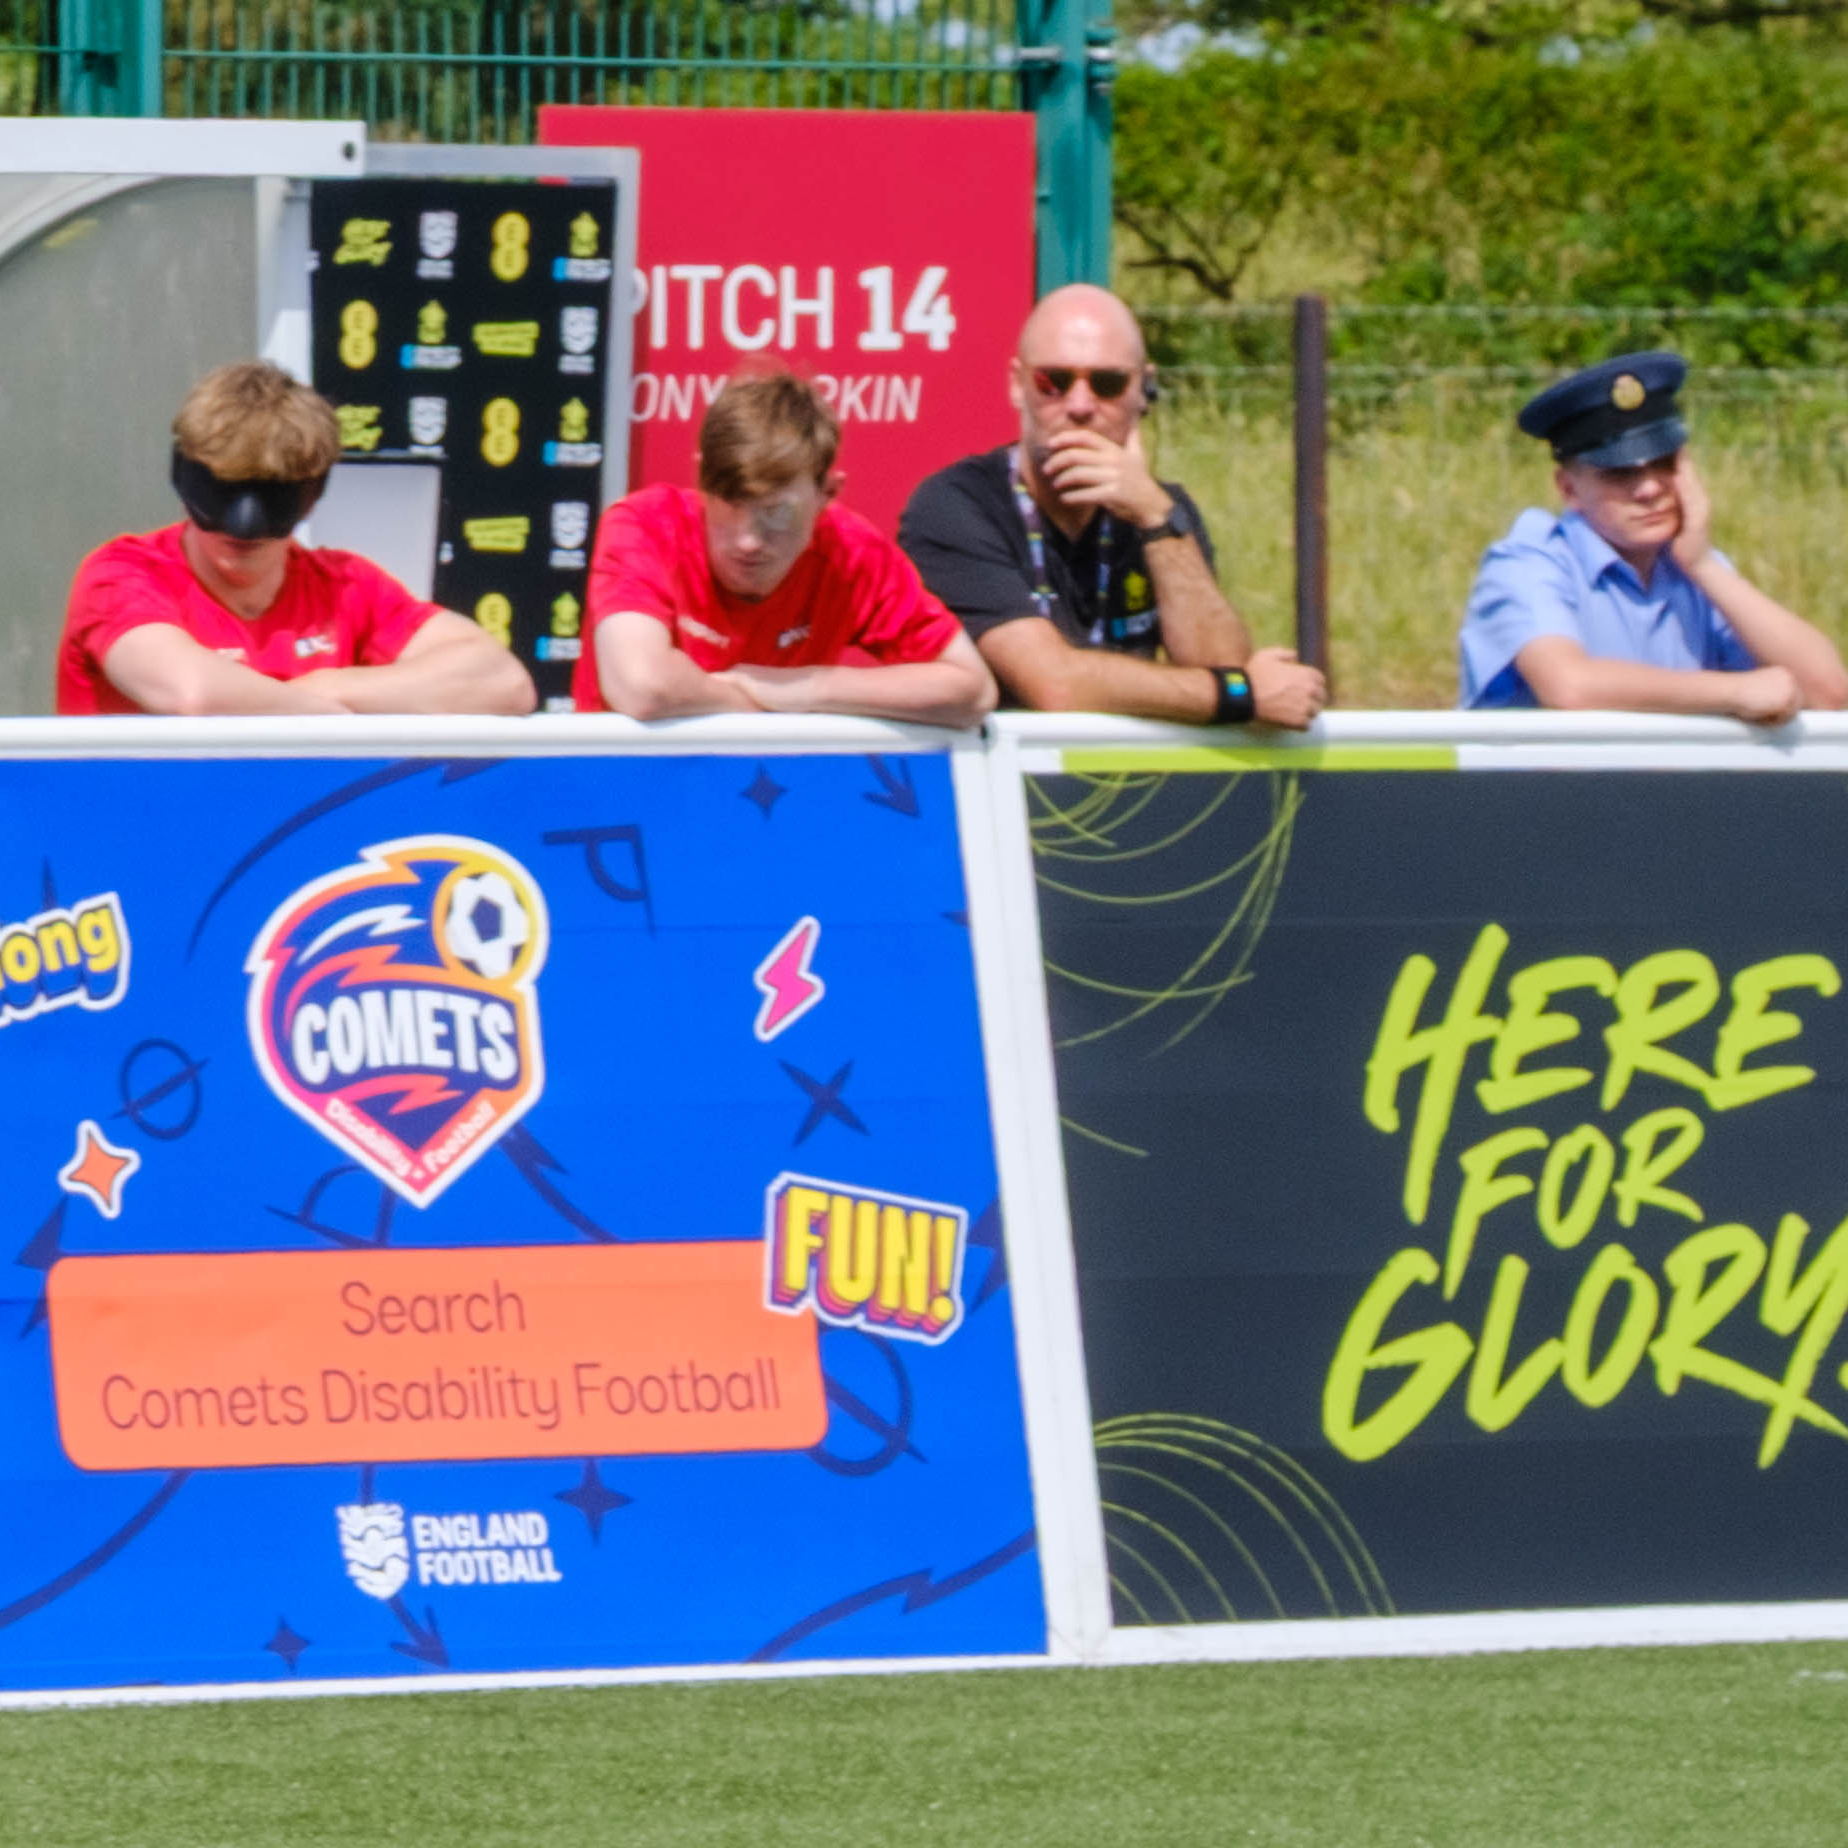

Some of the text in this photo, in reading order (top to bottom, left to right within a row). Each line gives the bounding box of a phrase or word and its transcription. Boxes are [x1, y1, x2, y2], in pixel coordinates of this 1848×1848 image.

[857, 265, 957, 352] 14
[632, 373, 728, 422] ONY
[292, 989, 519, 1085] COMETS
[1364, 923, 1841, 1225] HERE
[1444, 1107, 1705, 1301] FOR
[783, 1186, 958, 1322] FUN!
[341, 1279, 526, 1336] Search
[103, 1356, 782, 1431] Comets Disability Football
[412, 1512, 549, 1549] ENGLAND
[416, 1547, 563, 1586] FOOTBALL
